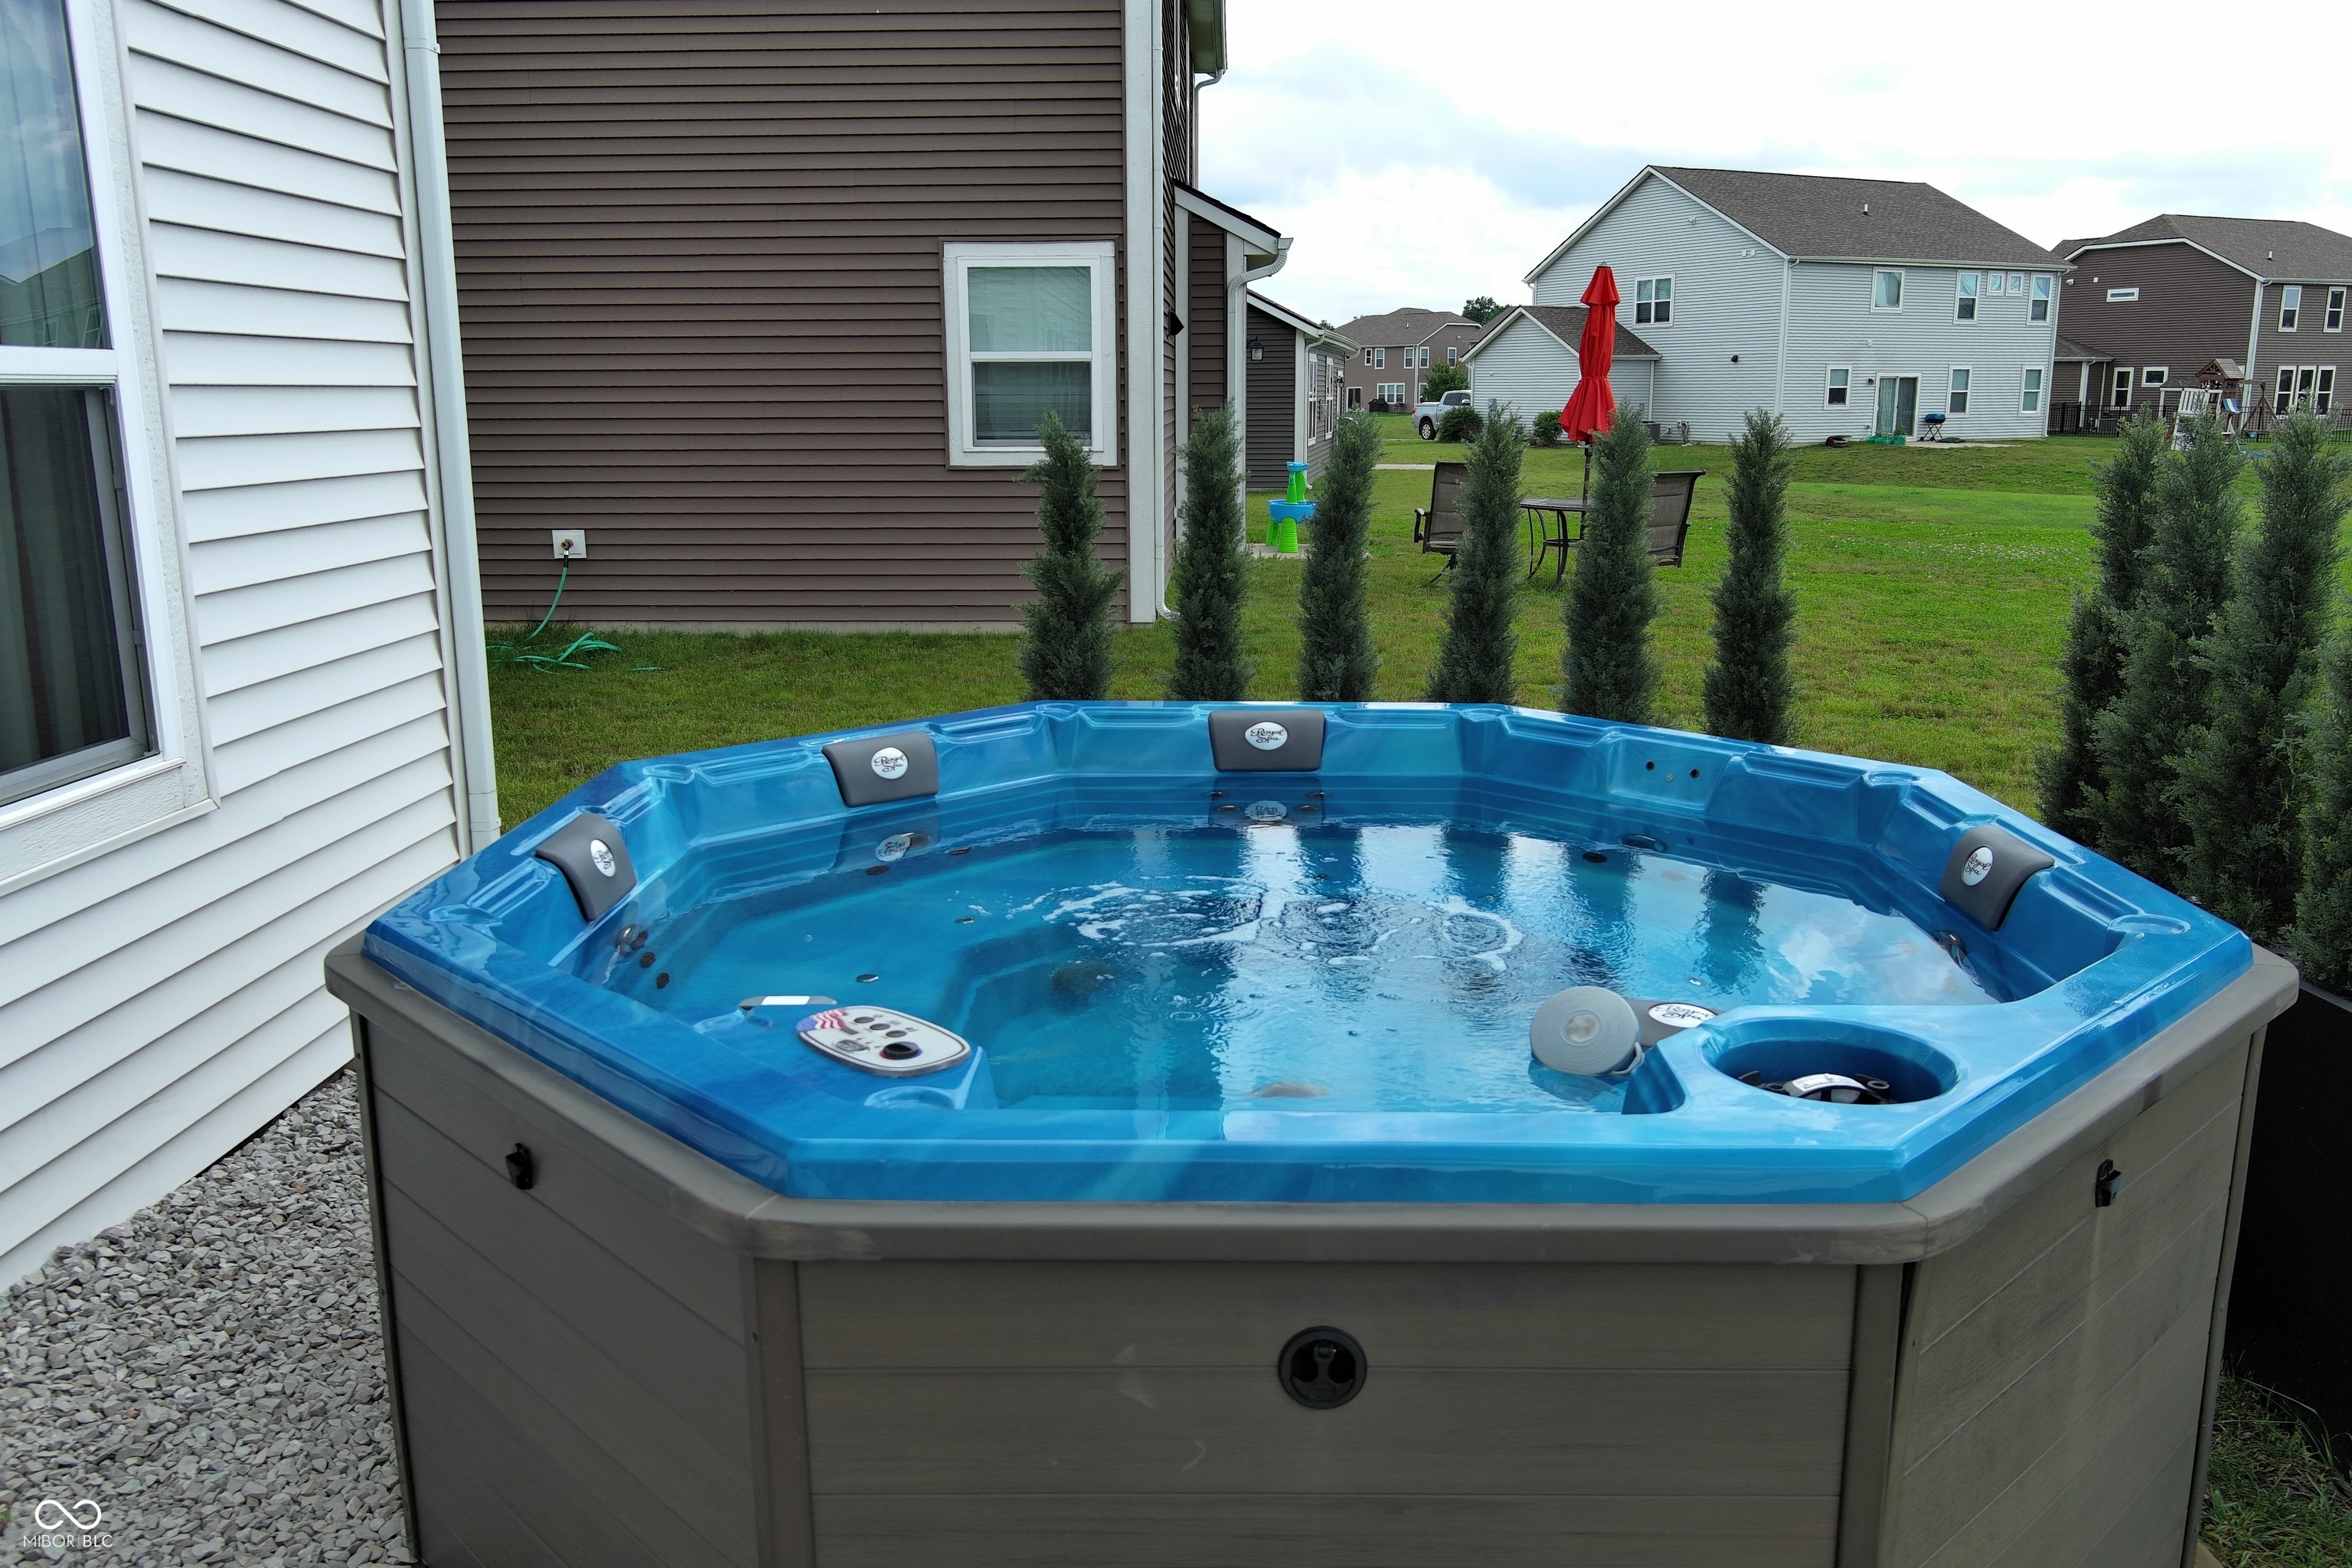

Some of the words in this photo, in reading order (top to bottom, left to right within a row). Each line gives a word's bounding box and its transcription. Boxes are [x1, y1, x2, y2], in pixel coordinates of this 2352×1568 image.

[1250, 727, 1285, 737] Royal
[1256, 735, 1282, 743] Spa
[882, 763, 903, 773] Spa
[1968, 853, 1991, 871] Royal
[1965, 863, 1982, 876] Spa
[1661, 1011, 1706, 1021] Spa
